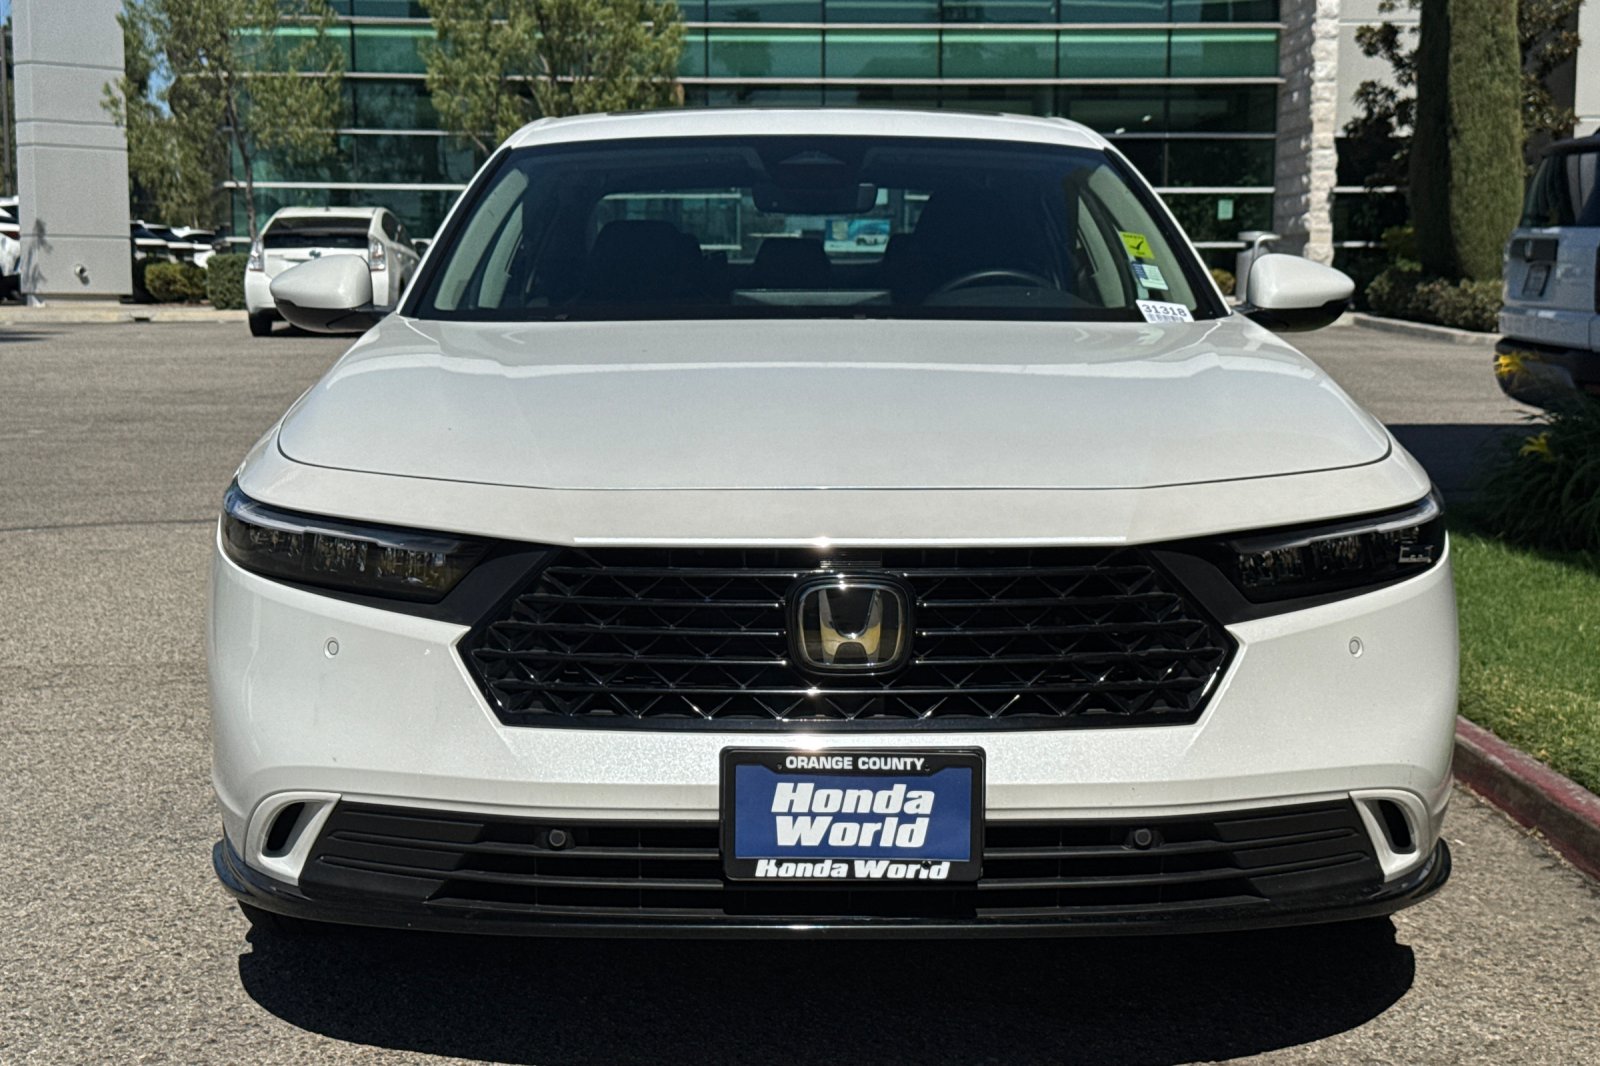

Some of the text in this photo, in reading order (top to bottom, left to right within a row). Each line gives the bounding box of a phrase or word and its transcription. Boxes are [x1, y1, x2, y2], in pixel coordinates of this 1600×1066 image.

[785, 755, 925, 771] ORANGE COUNTY
[771, 782, 935, 814] Honda
[775, 815, 930, 848] World
[755, 859, 849, 878] Honda
